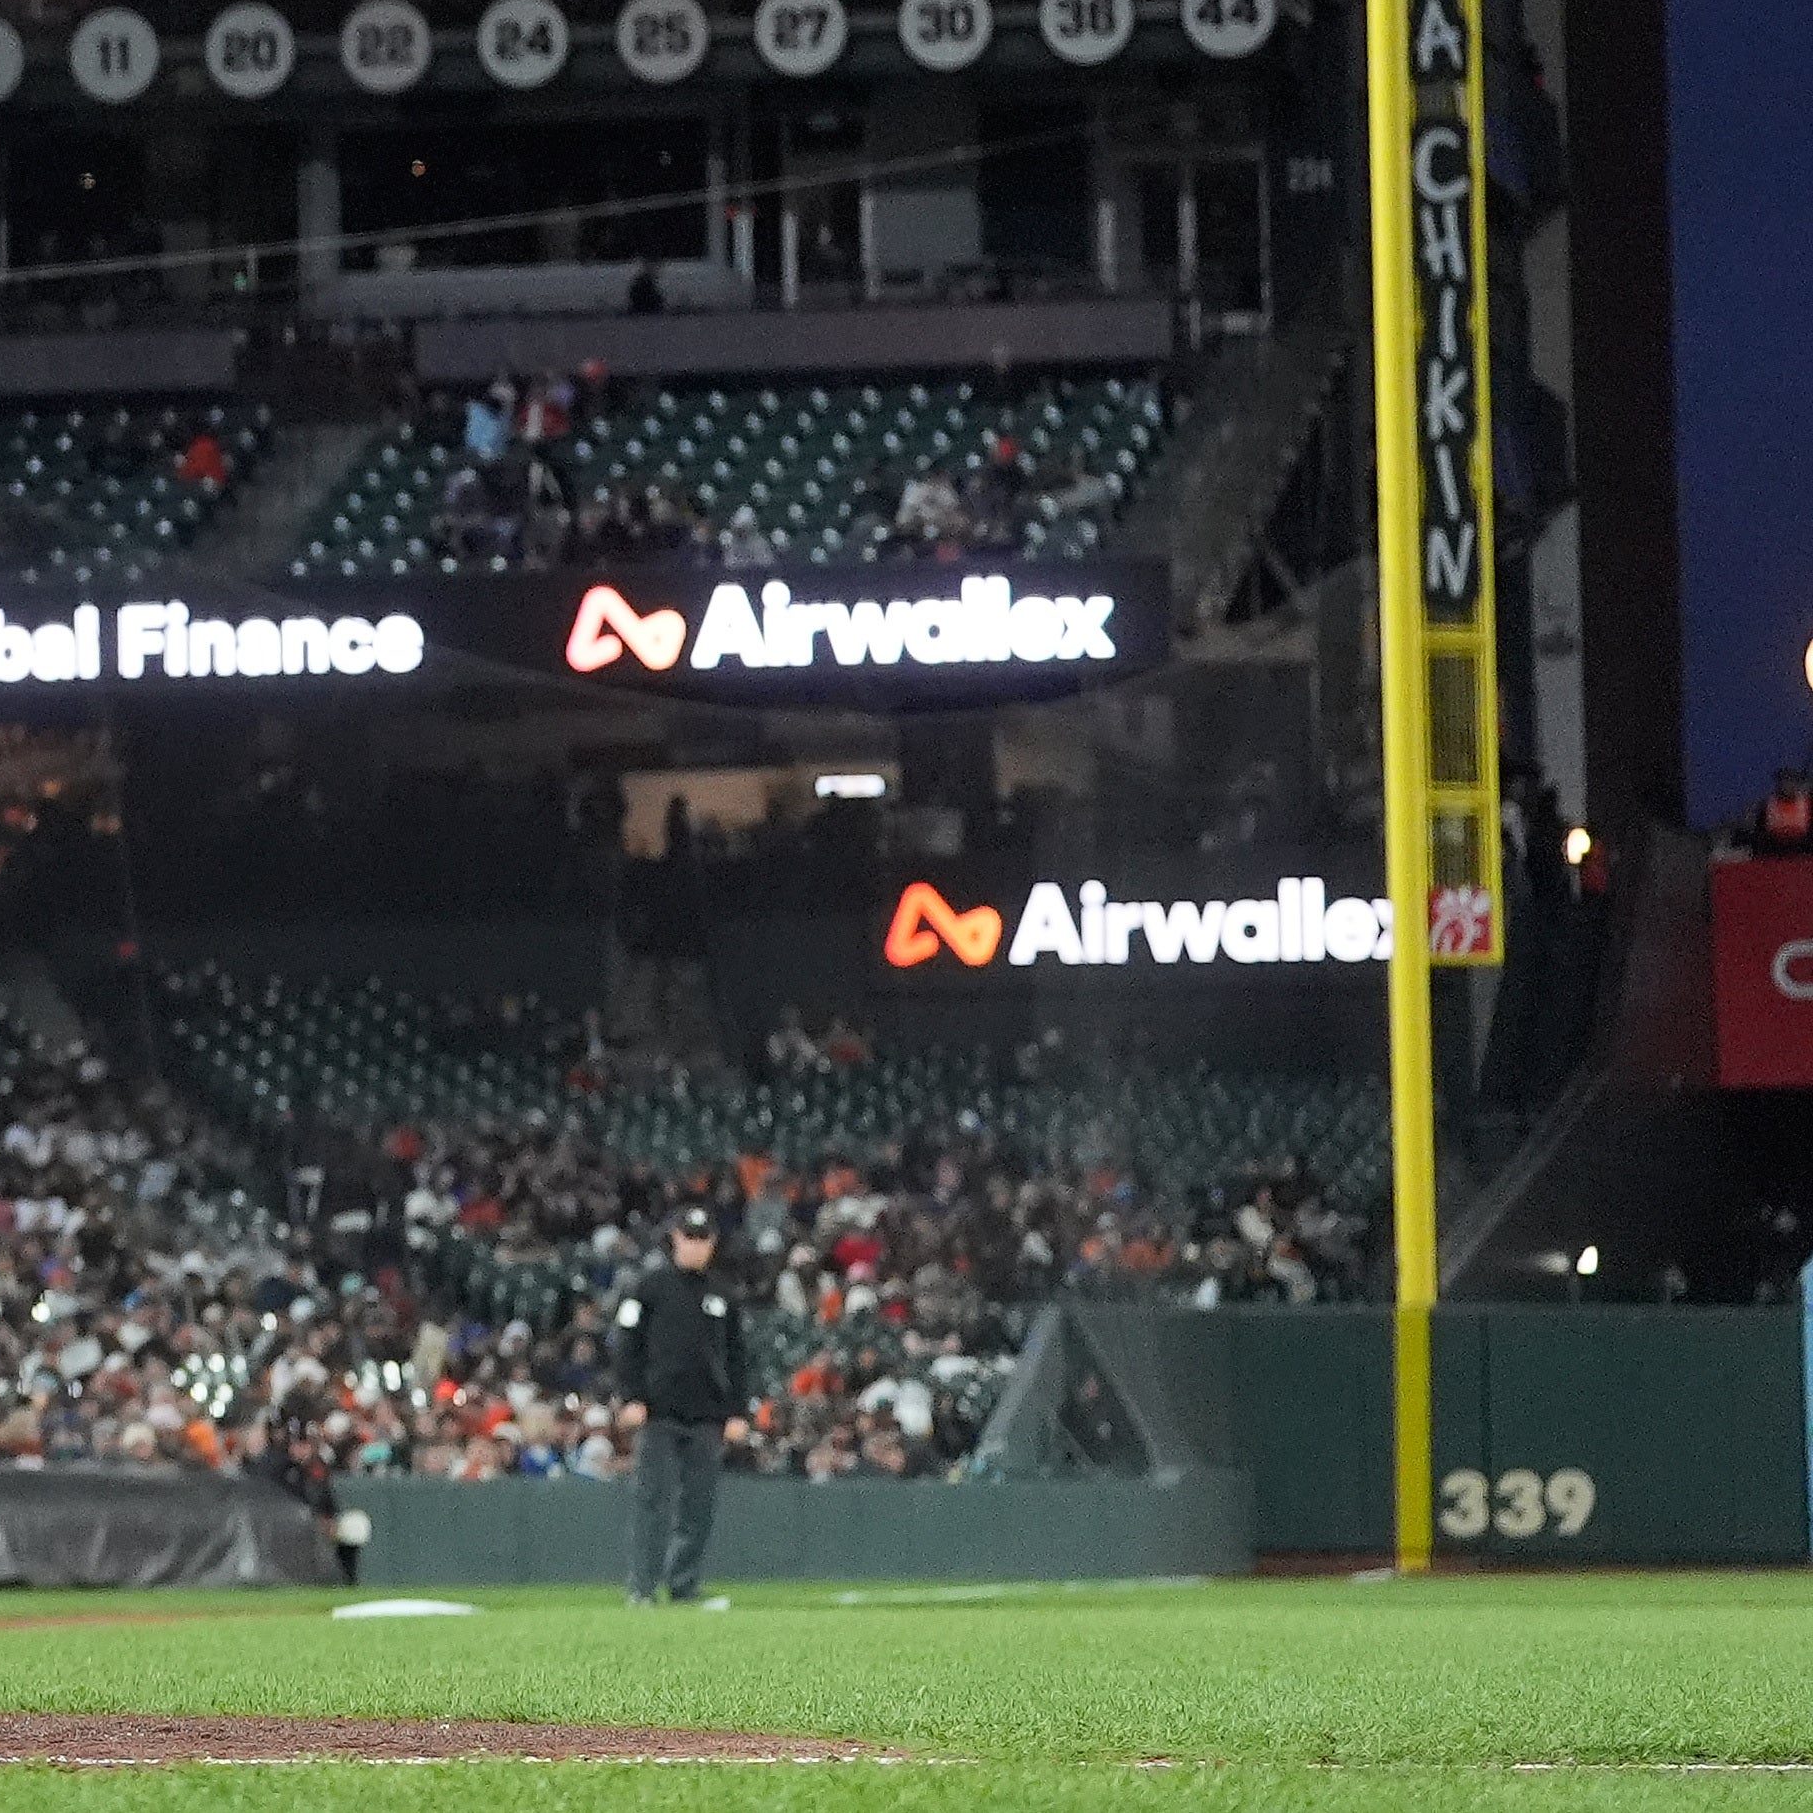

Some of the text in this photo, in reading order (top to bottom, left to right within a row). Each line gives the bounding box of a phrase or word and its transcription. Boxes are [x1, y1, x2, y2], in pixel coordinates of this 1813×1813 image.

[494, 18, 552, 67] 24
[774, 4, 829, 51] 27
[916, 0, 974, 44] 30
[97, 38, 132, 77] 11
[221, 29, 277, 72] 20
[1414, 126, 1475, 599] CHIKIN
[116, 600, 425, 680] Finance
[690, 575, 1117, 669] Airwallex
[1440, 1468, 1596, 1538] 339
